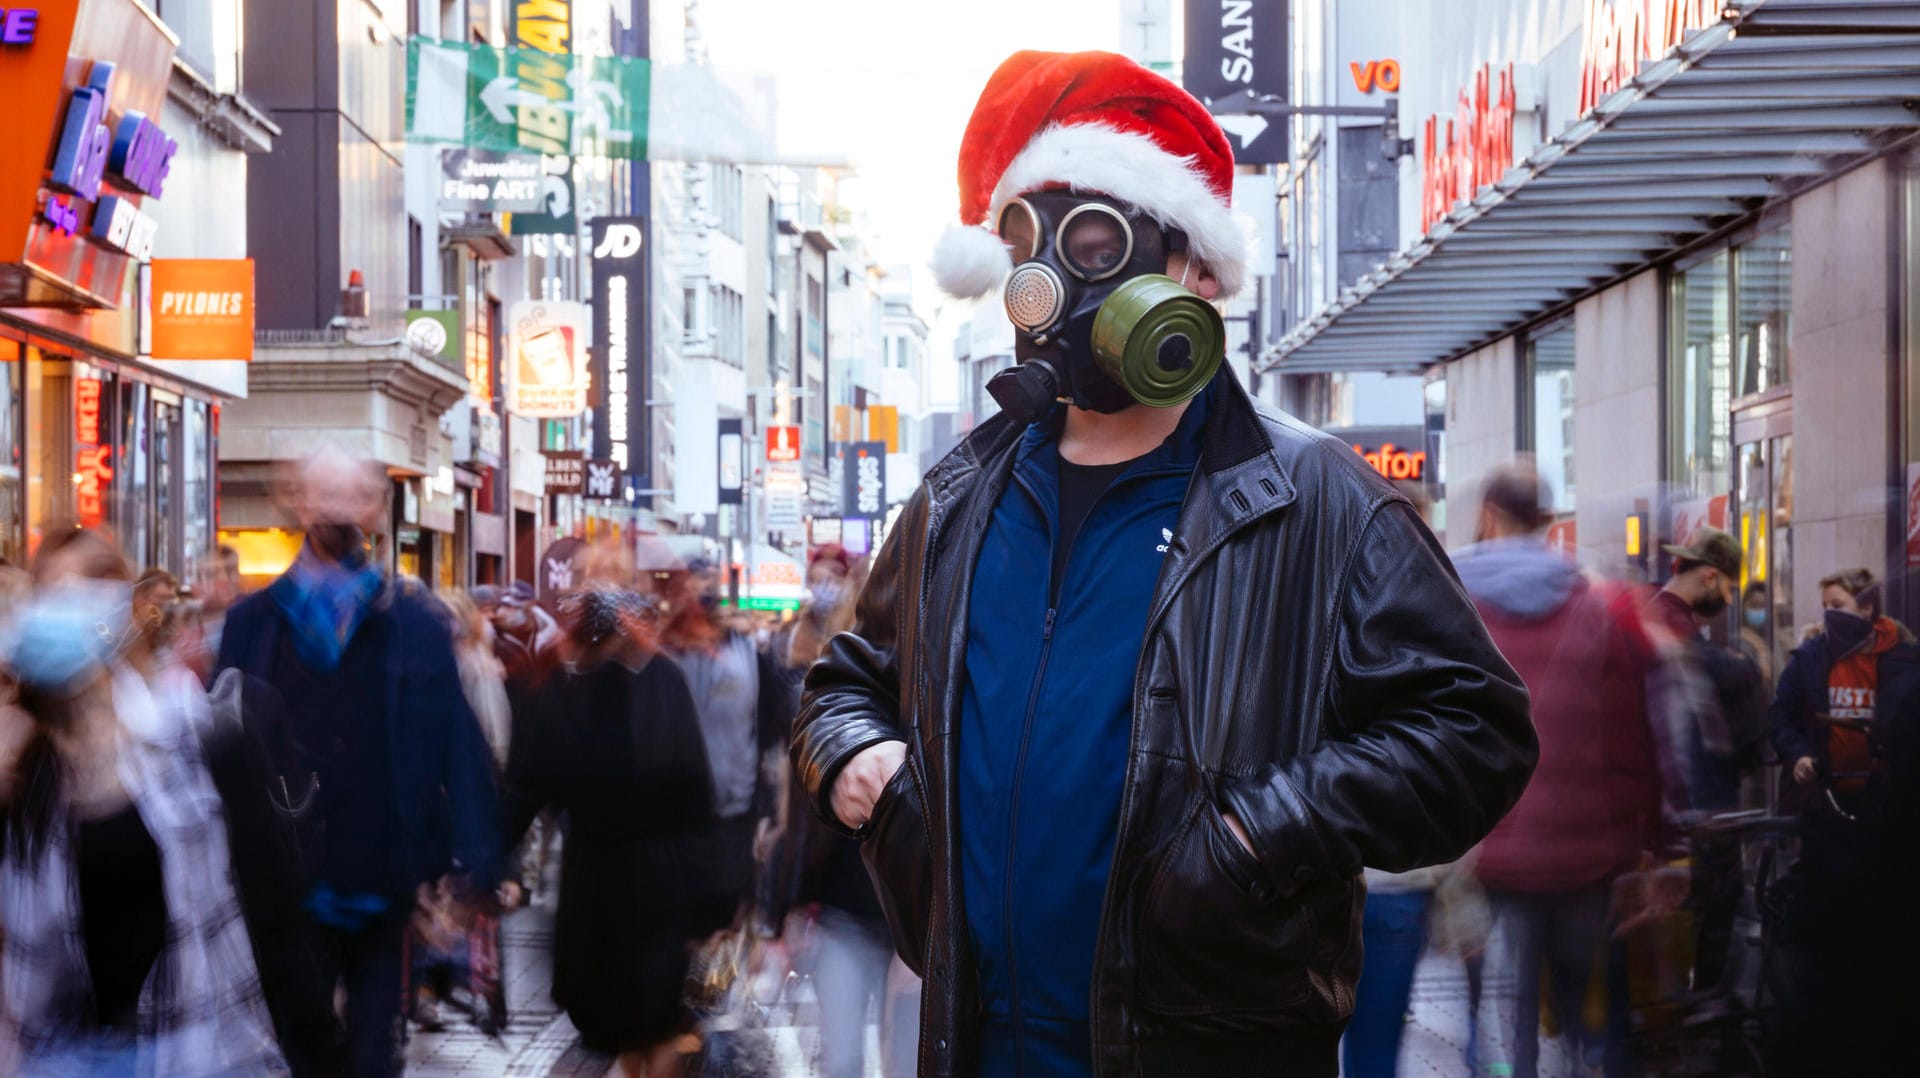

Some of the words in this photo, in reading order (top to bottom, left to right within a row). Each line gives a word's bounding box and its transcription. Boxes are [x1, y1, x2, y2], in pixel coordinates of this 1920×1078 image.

[461, 160, 538, 177] Juwelier
[444, 180, 489, 200] Fine
[492, 180, 537, 200] ART
[594, 224, 642, 259] JD
[161, 291, 243, 315] PYLONES
